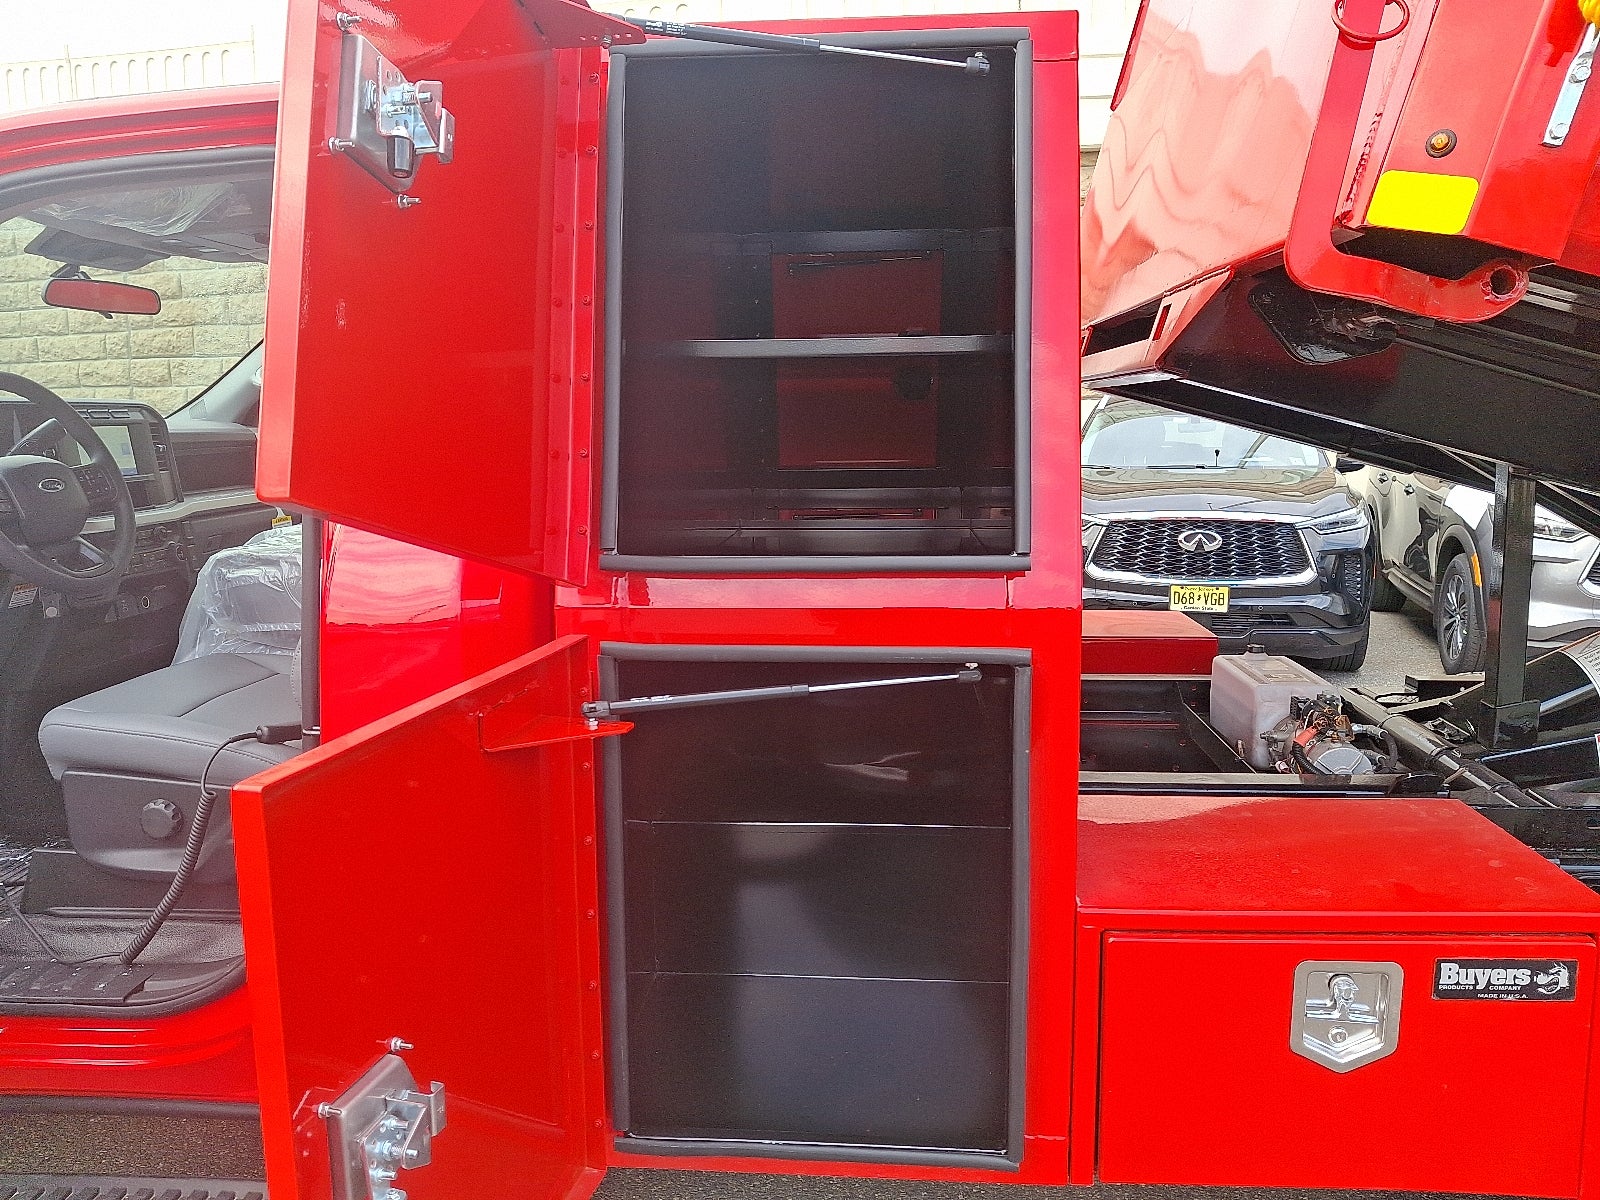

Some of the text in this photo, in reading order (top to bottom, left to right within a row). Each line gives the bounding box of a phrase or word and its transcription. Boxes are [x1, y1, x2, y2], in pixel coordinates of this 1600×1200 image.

[1173, 591, 1225, 606] D68 VGB
[1439, 962, 1532, 990] Buyers
